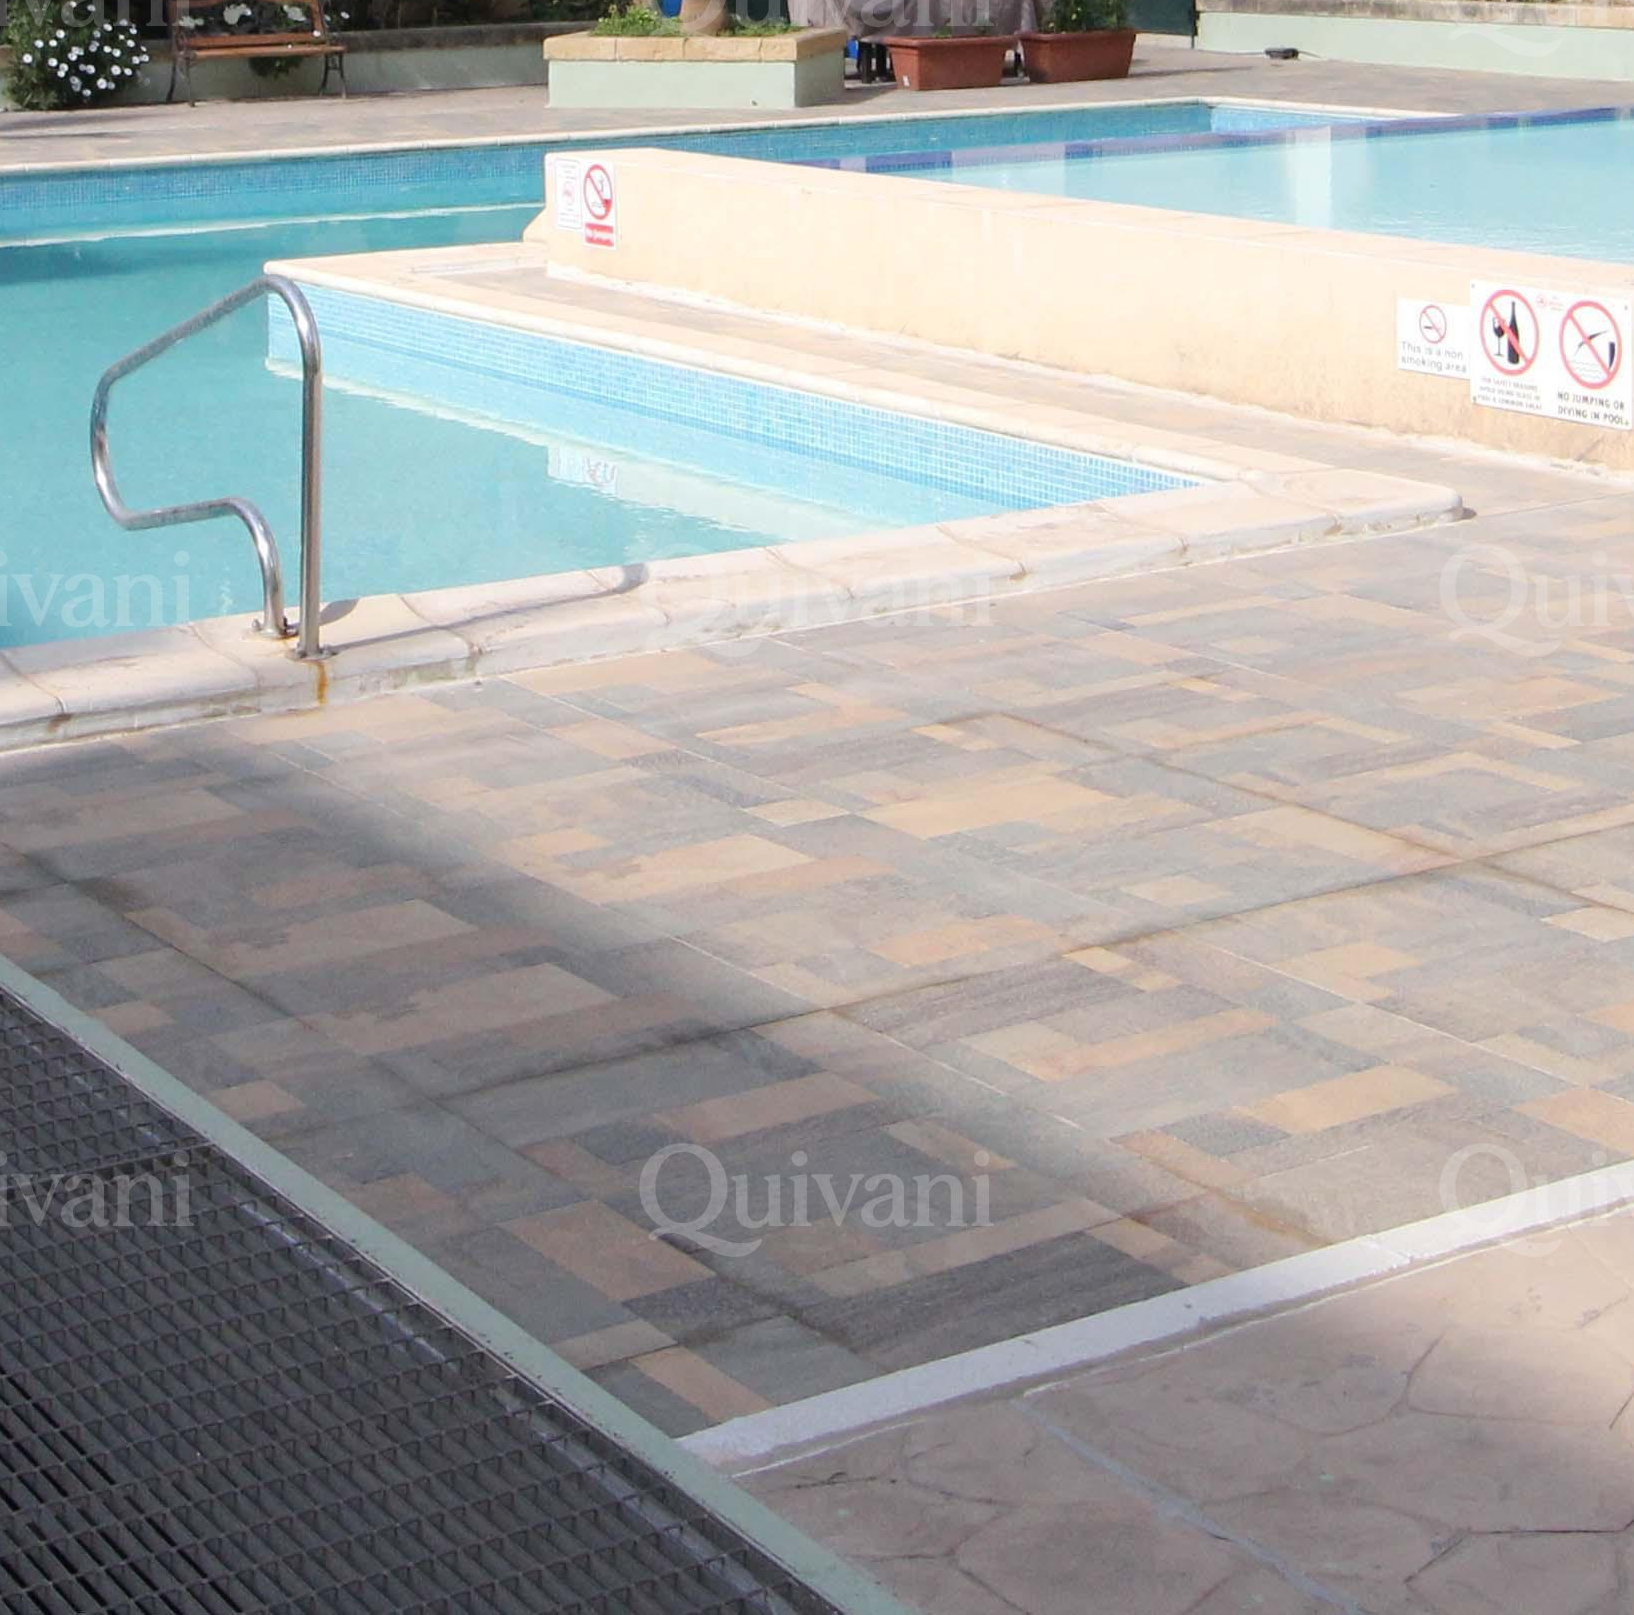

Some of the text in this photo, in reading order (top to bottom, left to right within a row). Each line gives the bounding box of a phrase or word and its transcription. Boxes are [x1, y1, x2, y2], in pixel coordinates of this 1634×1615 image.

[1402, 340, 1422, 354] This
[1445, 350, 1464, 360] non
[1401, 356, 1468, 373] smoking area
[1557, 390, 1625, 410] NO JUMPING OR
[1558, 404, 1625, 425] DIVING IN POOL
